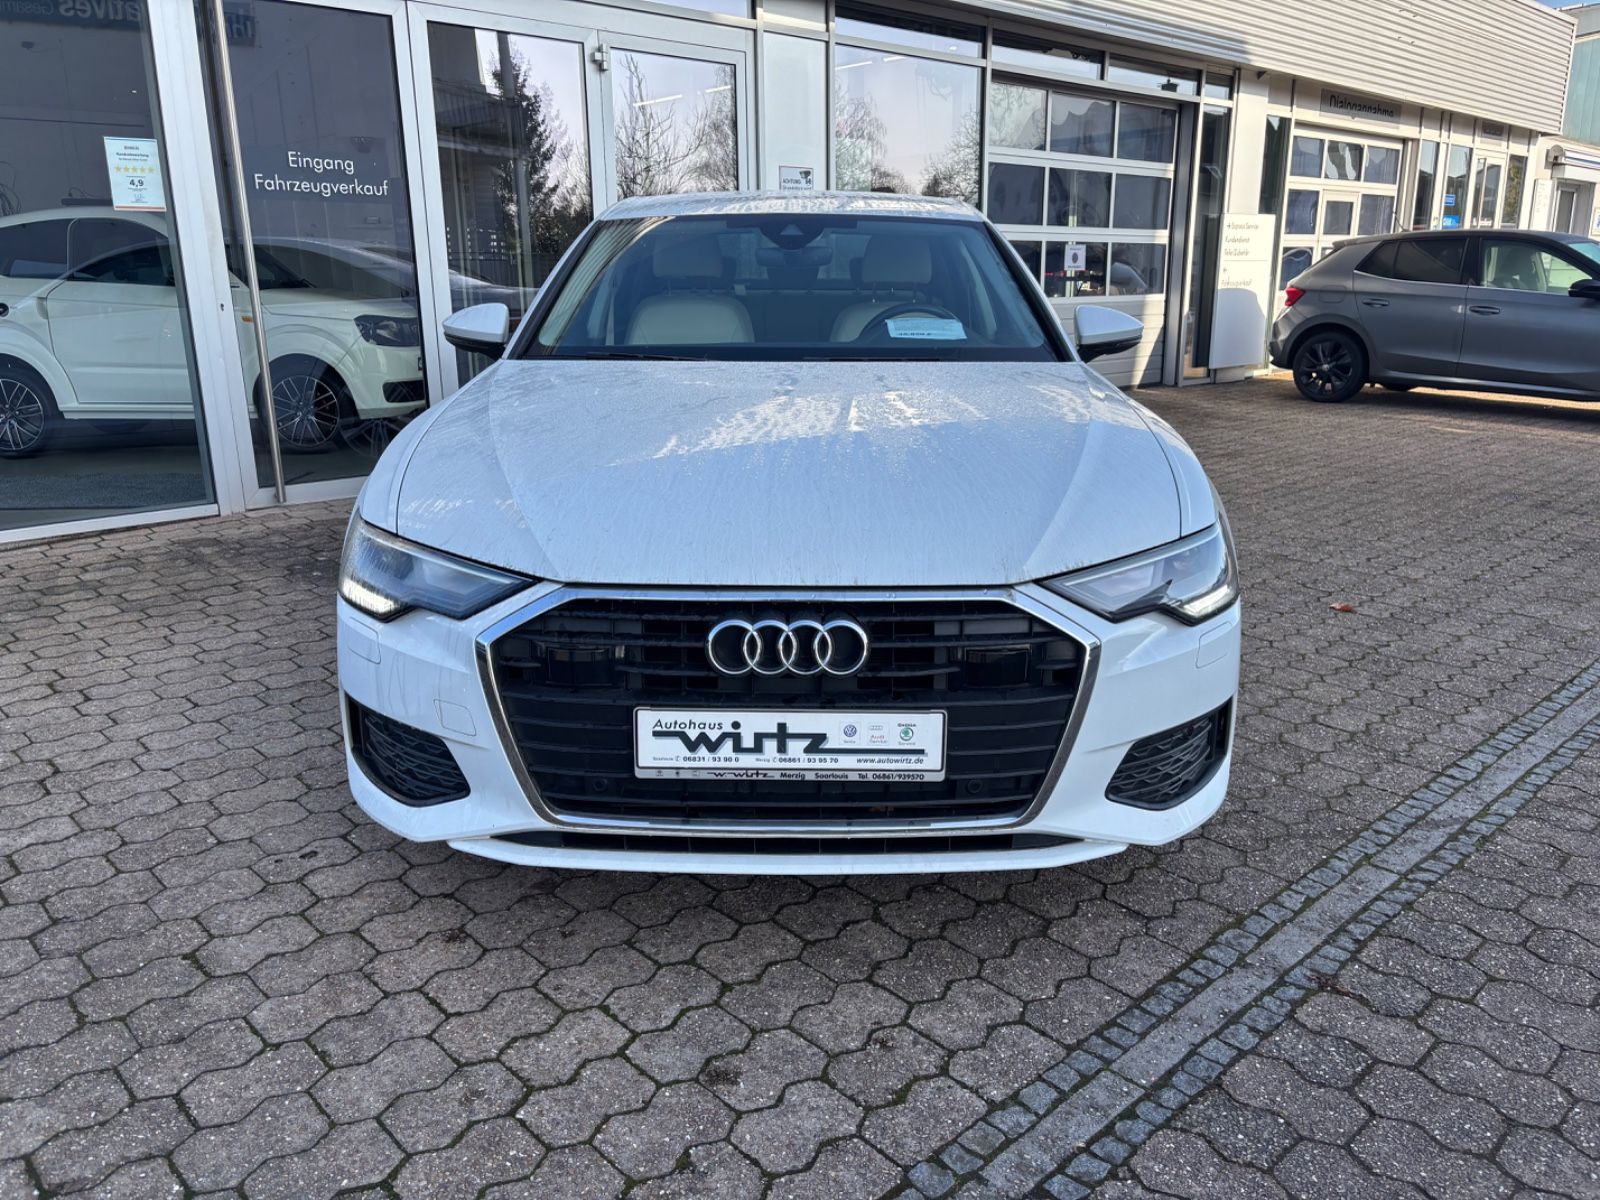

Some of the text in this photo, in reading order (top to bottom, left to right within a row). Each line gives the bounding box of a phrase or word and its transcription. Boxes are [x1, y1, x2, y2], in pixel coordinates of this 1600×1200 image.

[287, 150, 355, 175] Eingang
[129, 178, 144, 188] 4,9
[253, 172, 389, 198] Fahrzeugverkauf
[652, 718, 724, 730] Autohaus
[857, 756, 925, 765] www.autowirtz.de
[780, 771, 849, 781] Merzig Saarlouis
[872, 773, 925, 781] 06861/939570
